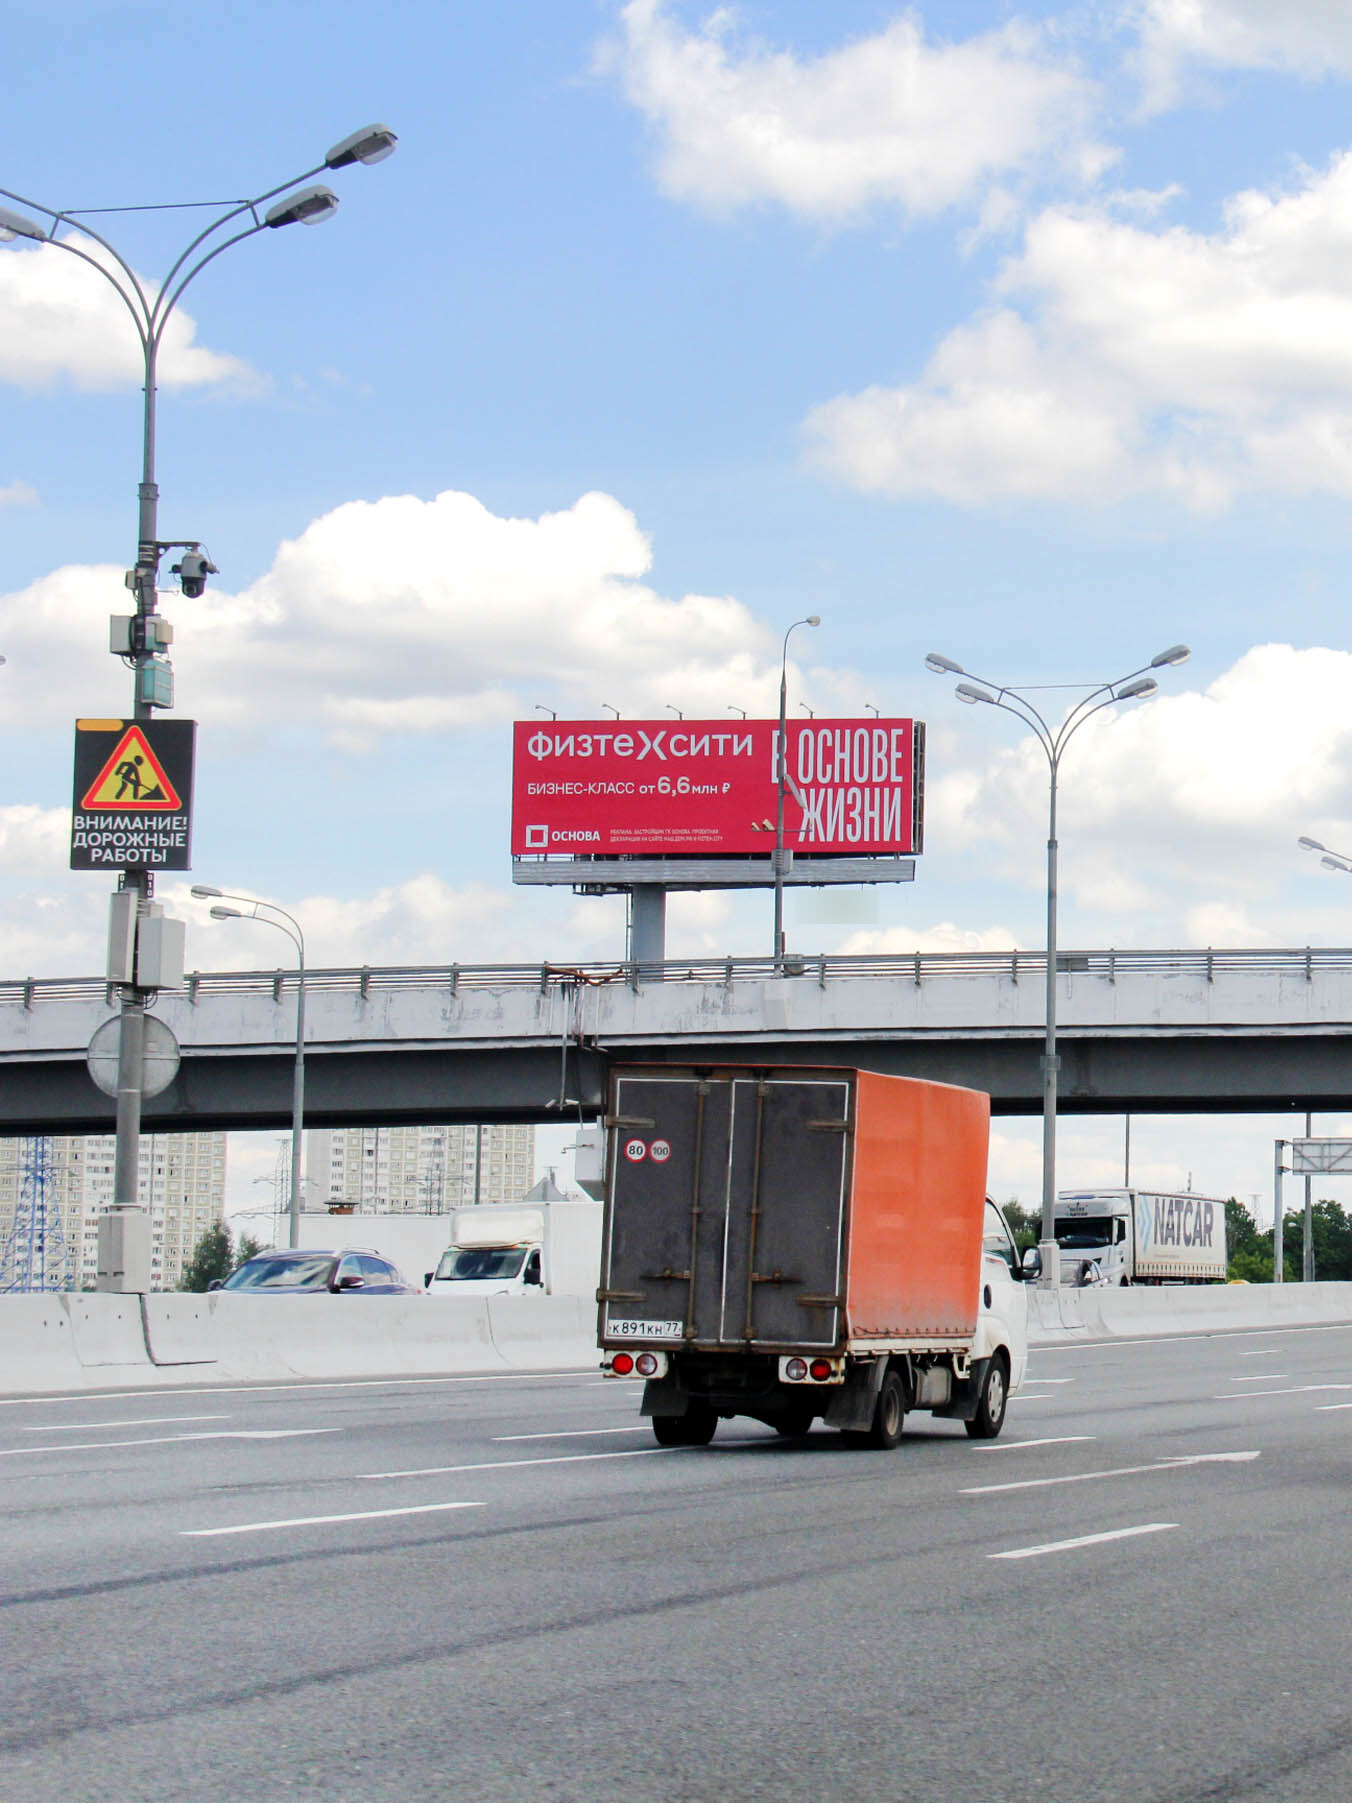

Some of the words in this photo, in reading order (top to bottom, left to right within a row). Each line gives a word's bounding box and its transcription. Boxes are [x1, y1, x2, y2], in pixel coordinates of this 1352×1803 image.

[797, 728, 904, 784] ОСНОВЕ
[527, 782, 635, 795] БИЗНЕС-КЛАСС
[639, 785, 655, 795] от
[657, 776, 690, 797] 6,6
[692, 785, 718, 795] млн
[797, 786, 902, 843] ЖИЗНИ
[73, 816, 187, 830] ВНИМАНИЕ!
[73, 832, 186, 848] ДОРОЖНЫЕ
[552, 829, 600, 841] ОСНОВА
[91, 849, 167, 862] РАБОТЫ
[628, 1145, 644, 1156] 80
[652, 1146, 669, 1156] 100
[1153, 1197, 1214, 1247] NATCAR
